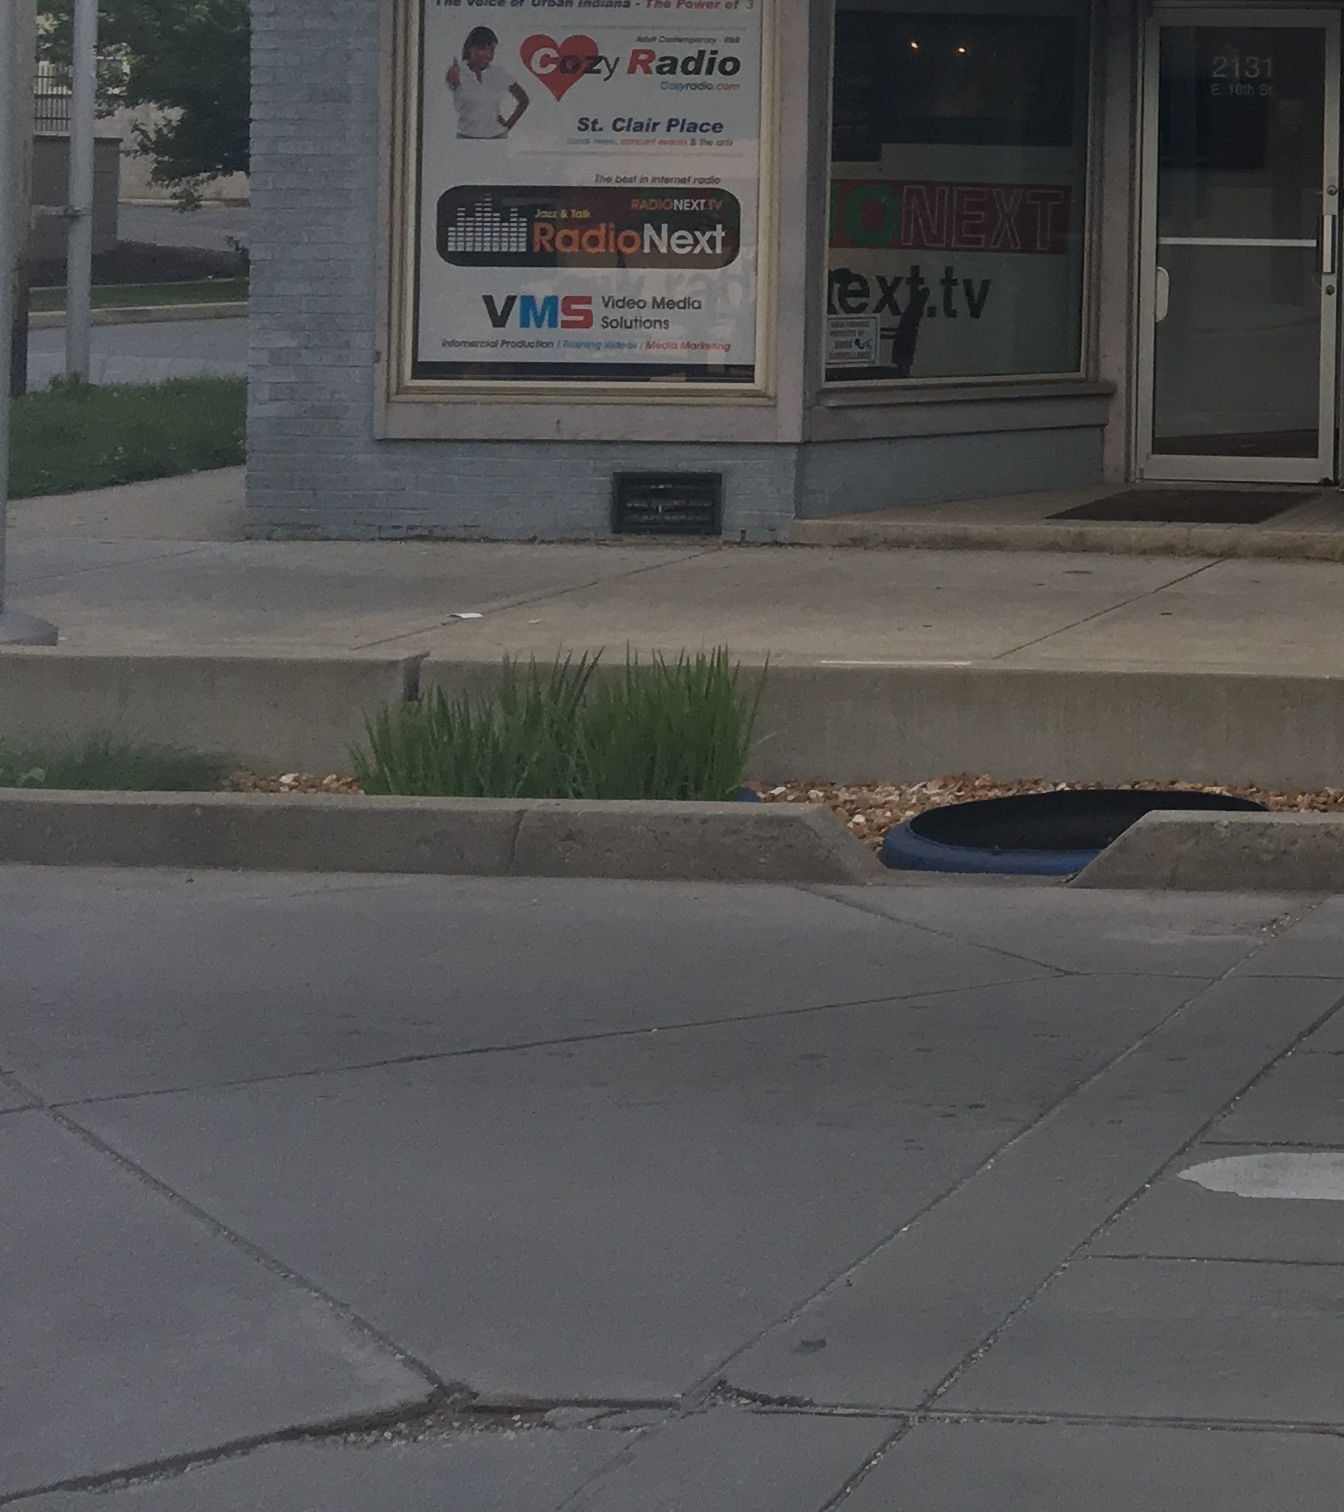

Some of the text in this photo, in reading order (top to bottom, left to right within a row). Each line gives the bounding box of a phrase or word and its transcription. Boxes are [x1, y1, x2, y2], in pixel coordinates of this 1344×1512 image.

[724, 0, 739, 9] of
[746, 0, 754, 9] 3
[530, 47, 741, 81] Cozy Radio
[1212, 56, 1272, 78] 2131
[577, 117, 724, 134] St. Clair Place
[594, 174, 612, 183] The
[615, 174, 637, 183] best
[640, 175, 649, 183] in
[692, 175, 721, 184] radio
[531, 222, 726, 255] RadioNext
[601, 296, 701, 310] Video Media
[482, 295, 594, 329] VMS
[600, 316, 670, 330] Solutions
[500, 339, 554, 349] Production
[645, 341, 678, 350] Media
[680, 341, 731, 352] Marketing
